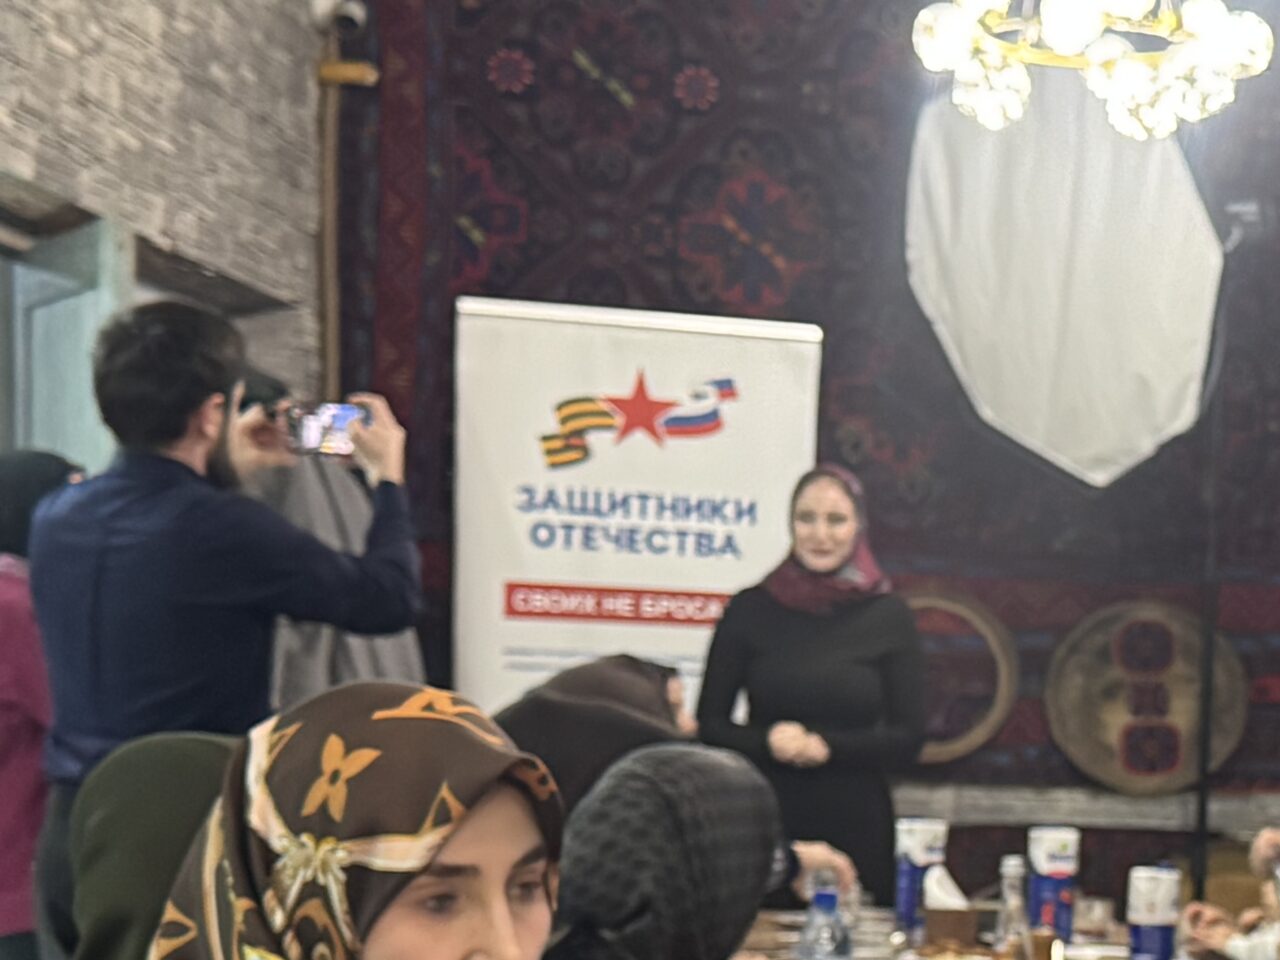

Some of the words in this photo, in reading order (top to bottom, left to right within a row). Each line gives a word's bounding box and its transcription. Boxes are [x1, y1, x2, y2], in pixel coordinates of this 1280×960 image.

[516, 486, 757, 527] ЗАЩИТНИКИ
[530, 522, 741, 559] ОТЕЧЕСТВА
[511, 588, 597, 614] СВОИХ
[602, 591, 636, 617] НЕ
[640, 593, 724, 620] БРОСА
